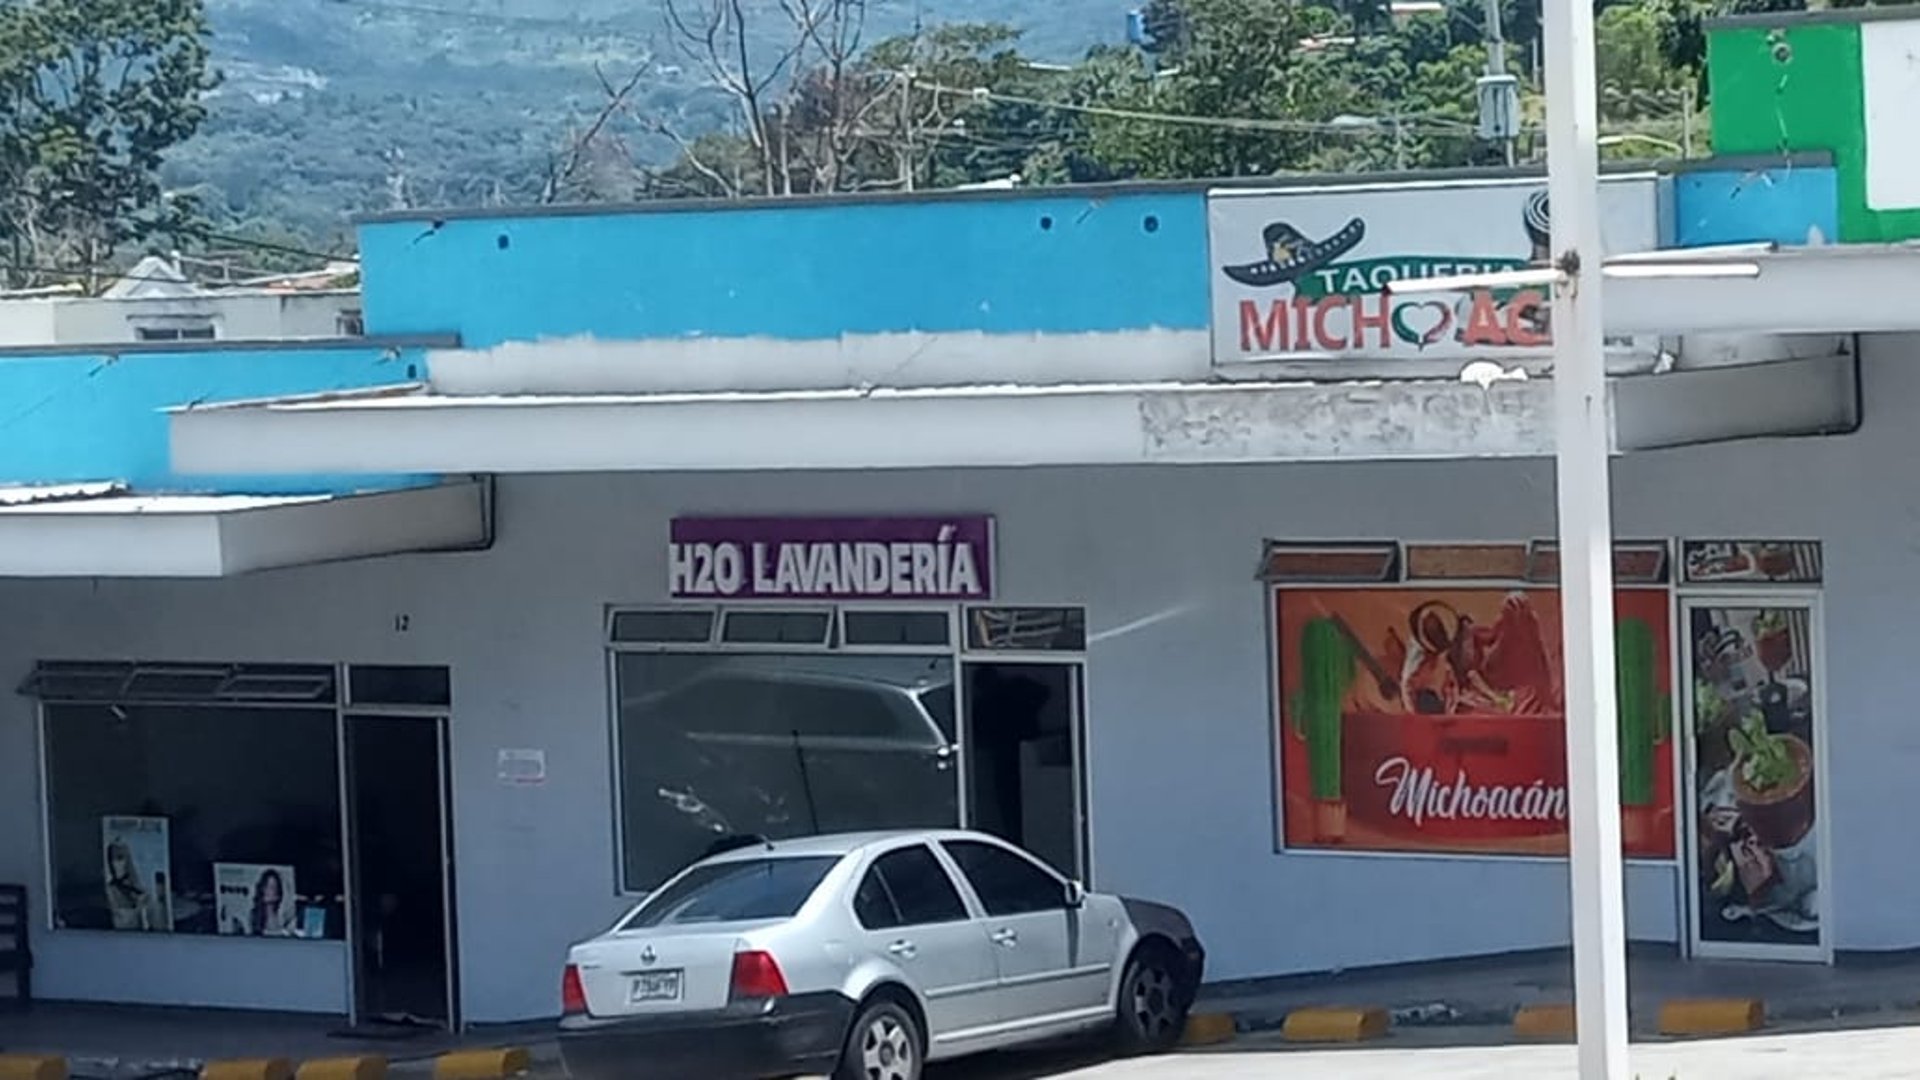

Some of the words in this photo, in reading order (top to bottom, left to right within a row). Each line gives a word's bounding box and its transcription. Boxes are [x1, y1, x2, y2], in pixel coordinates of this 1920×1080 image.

[669, 542, 743, 594] H2O
[753, 524, 982, 594] LAVANDERÍA
[395, 614, 410, 631] 12
[1375, 757, 1567, 826] Michoacán
